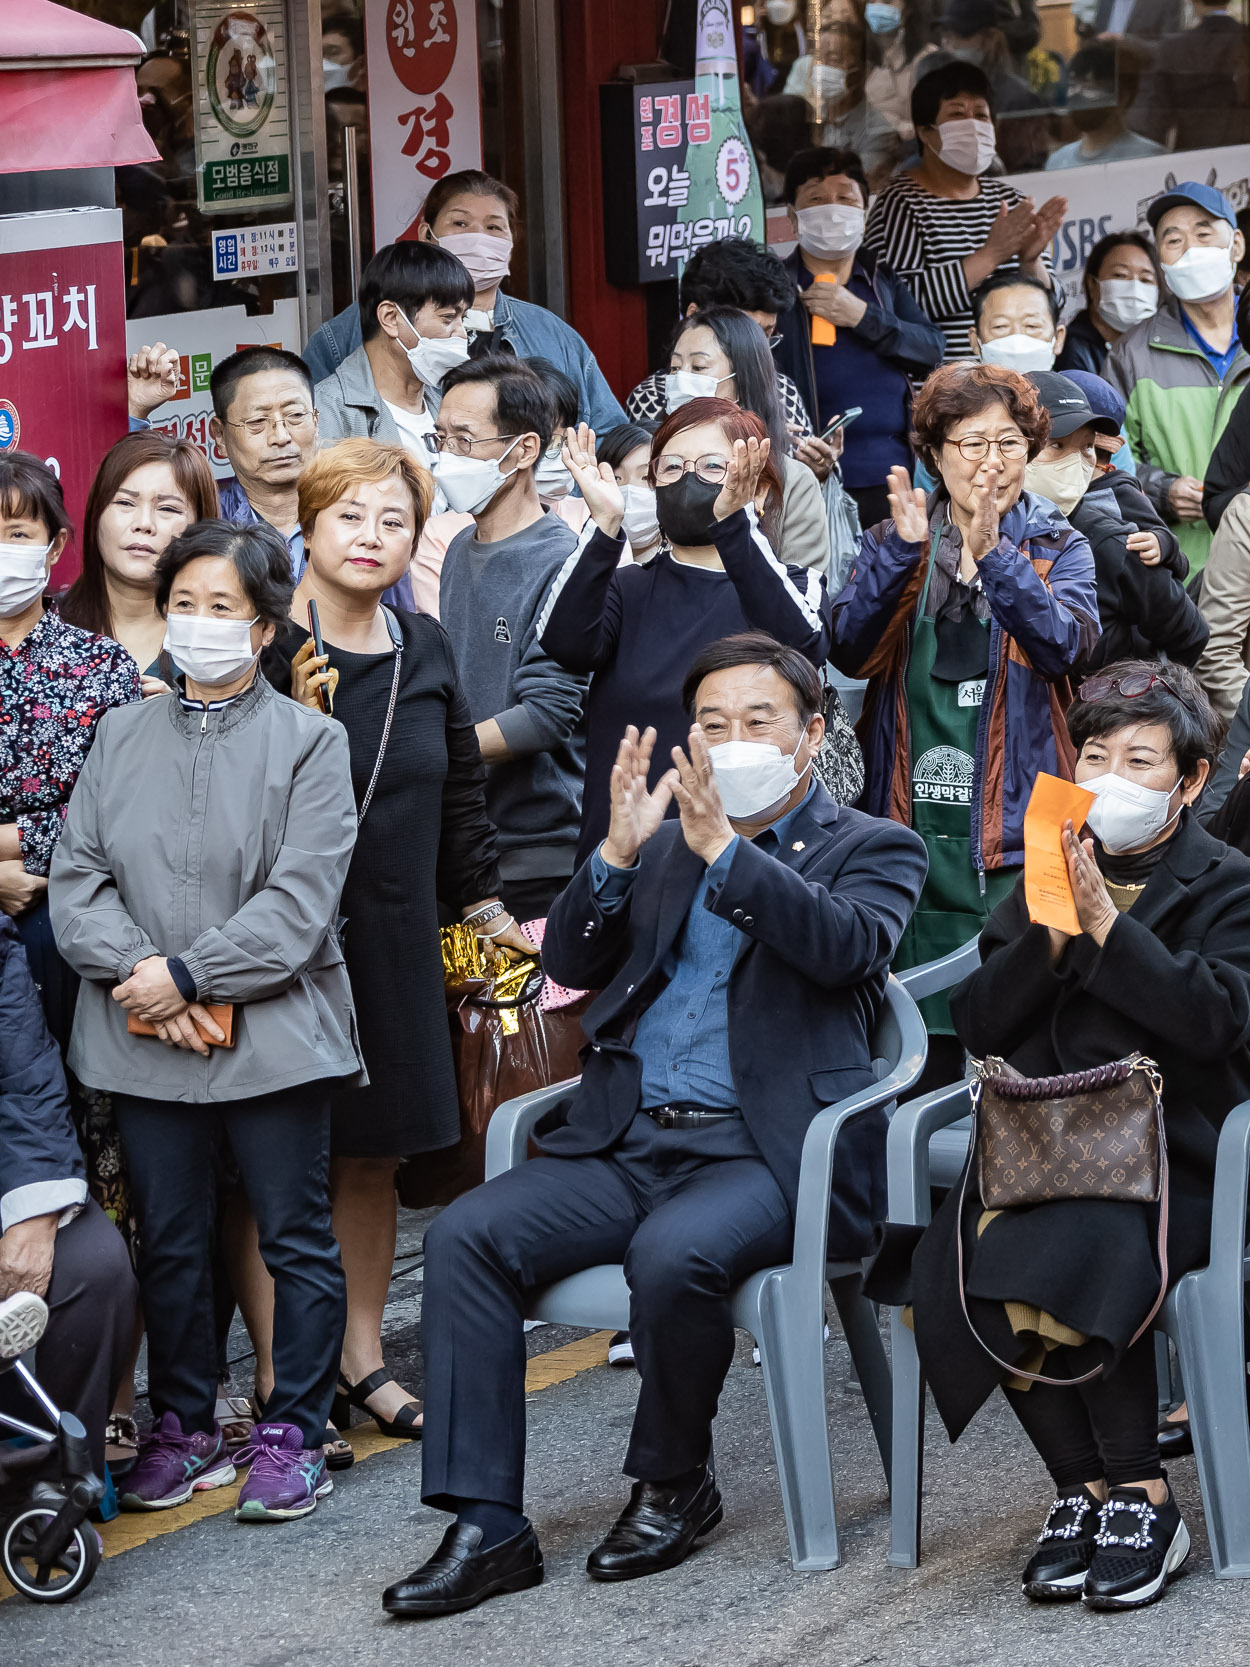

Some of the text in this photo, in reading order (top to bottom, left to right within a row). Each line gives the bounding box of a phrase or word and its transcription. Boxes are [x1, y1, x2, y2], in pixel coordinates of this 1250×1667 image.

[392, 0, 450, 58] 원조
[655, 94, 712, 148] 경성
[212, 160, 279, 188] 모범음식점
[643, 164, 691, 207] 오늘
[218, 238, 236, 254] 영업
[218, 255, 236, 270] 시간
[915, 783, 973, 801] 인생막걸
